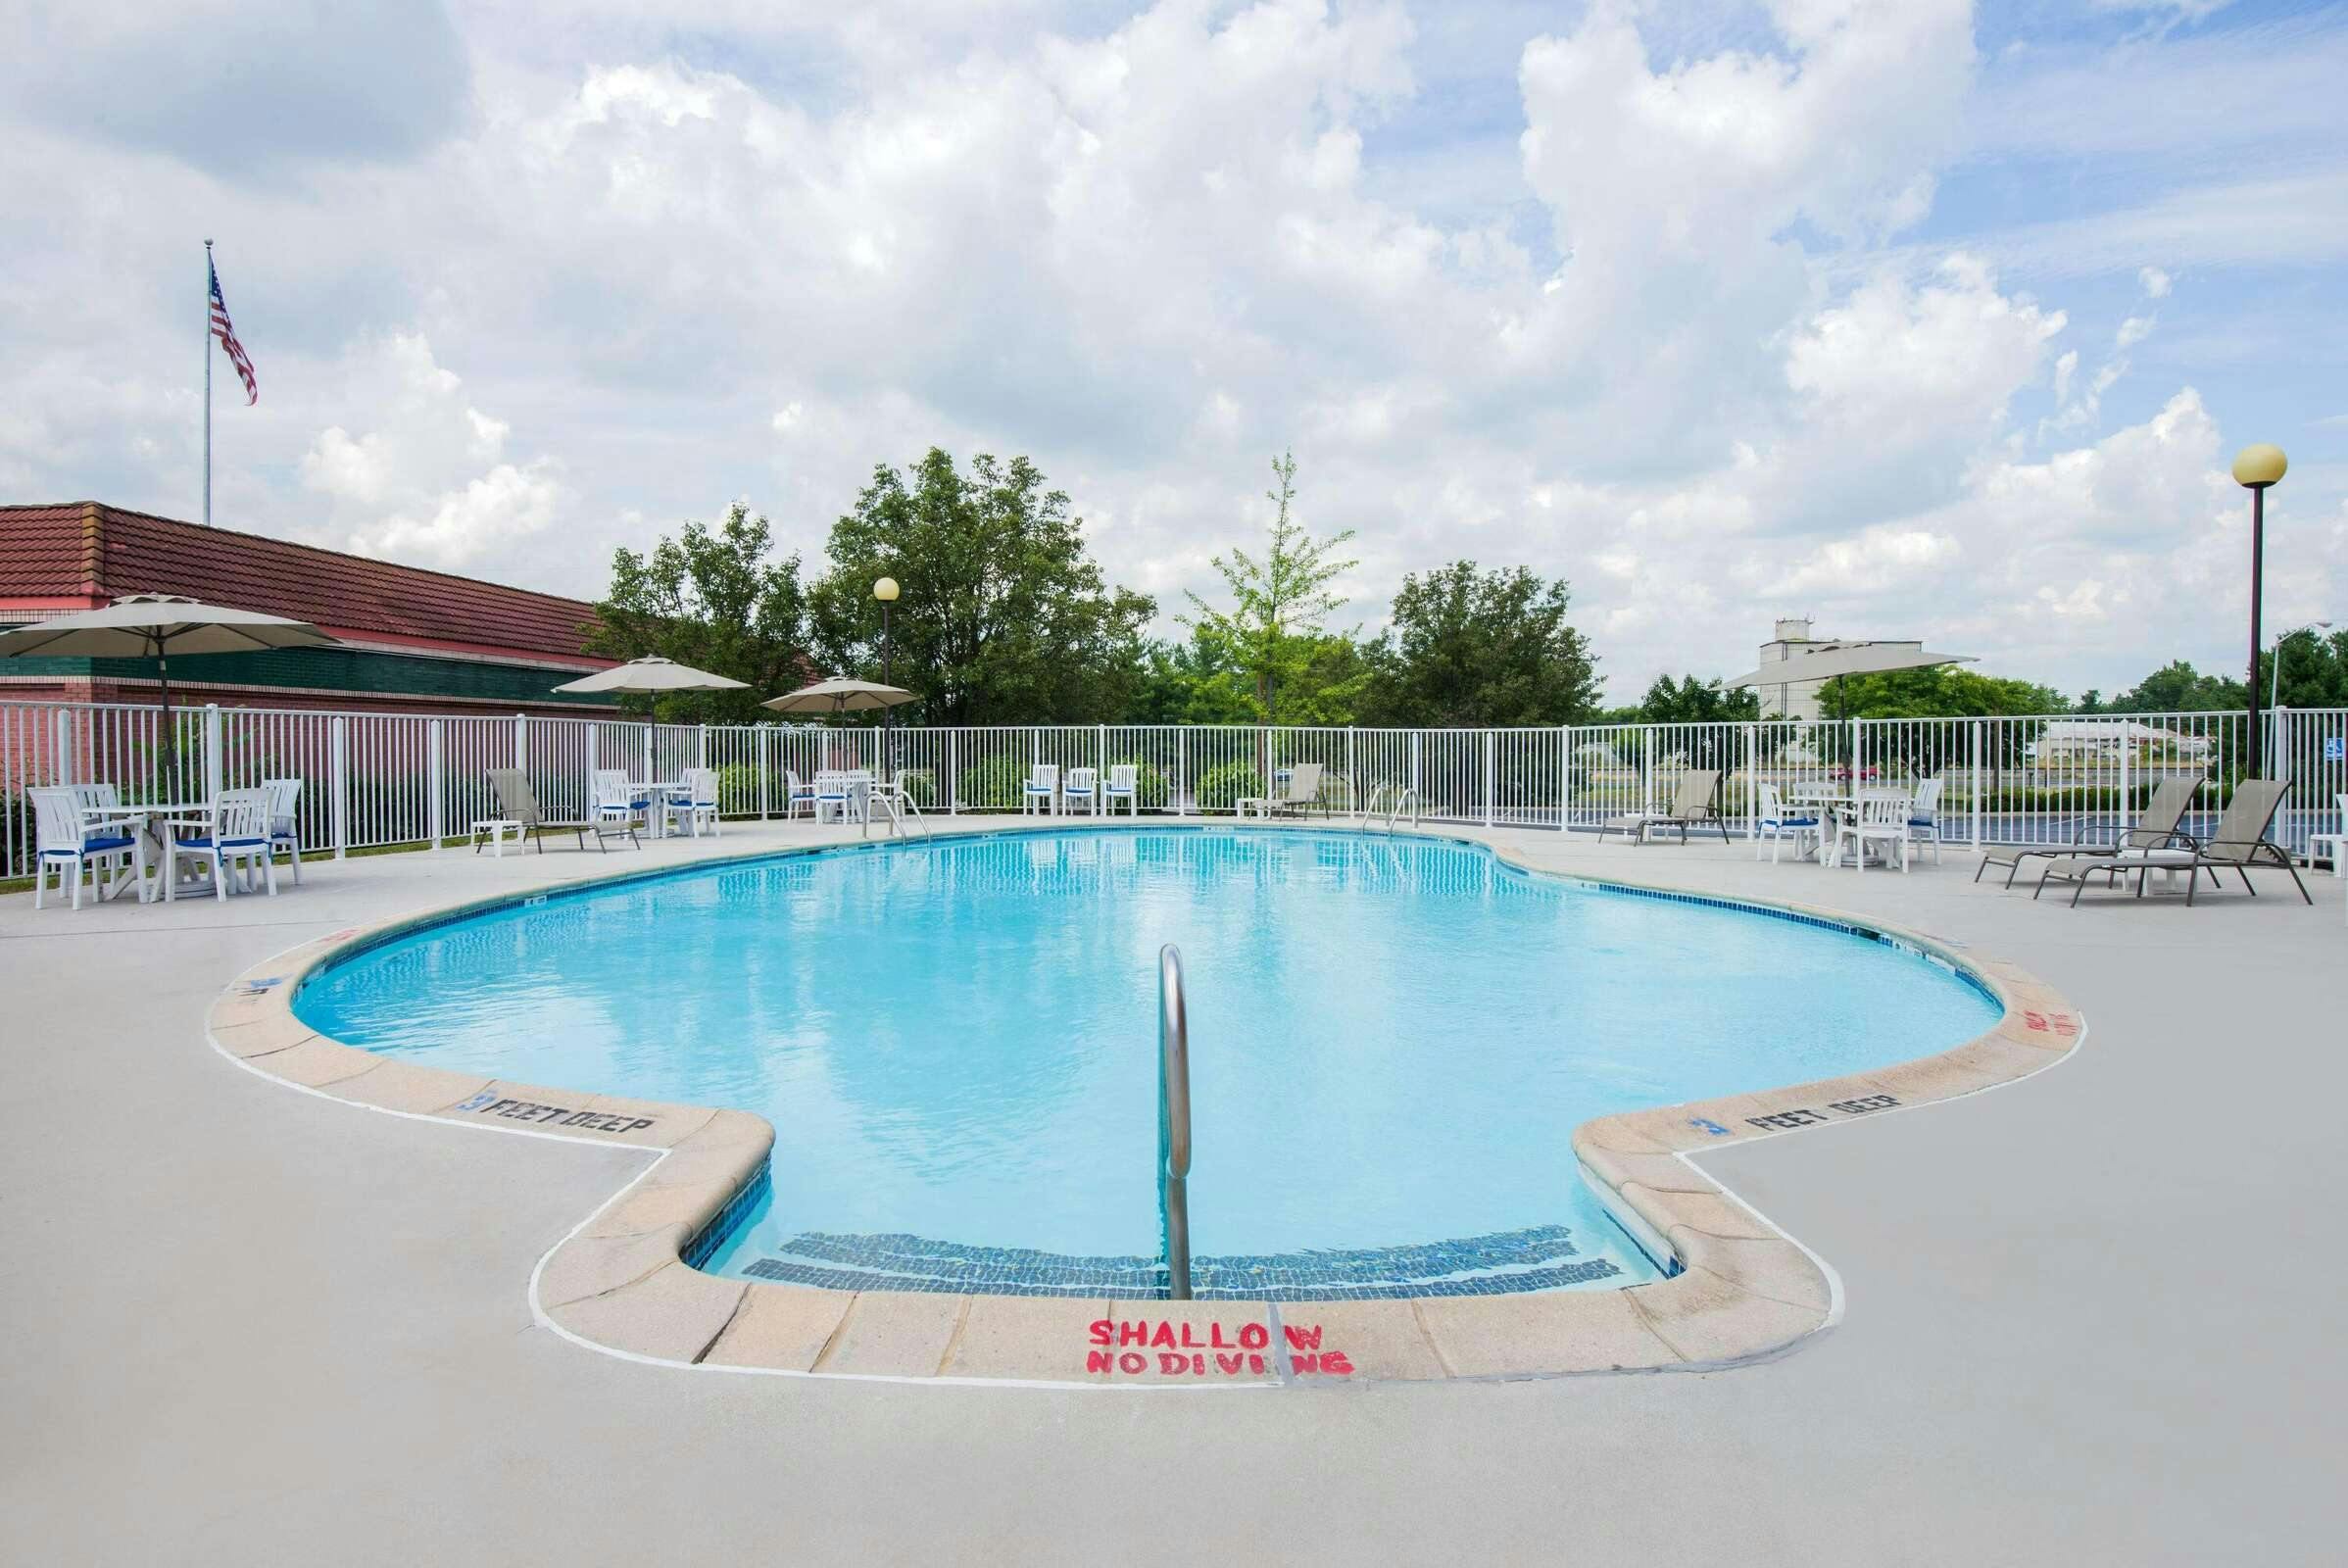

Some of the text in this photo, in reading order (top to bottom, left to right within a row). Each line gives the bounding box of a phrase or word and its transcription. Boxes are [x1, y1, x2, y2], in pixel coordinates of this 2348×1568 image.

[479, 1099, 569, 1123] FEET
[561, 1111, 655, 1133] DEEP
[1745, 1108, 1829, 1132] FEET
[1827, 1095, 1903, 1114] DEEP
[1089, 1319, 1323, 1350] SHALLOW
[1086, 1350, 1356, 1376] NO DIVING
